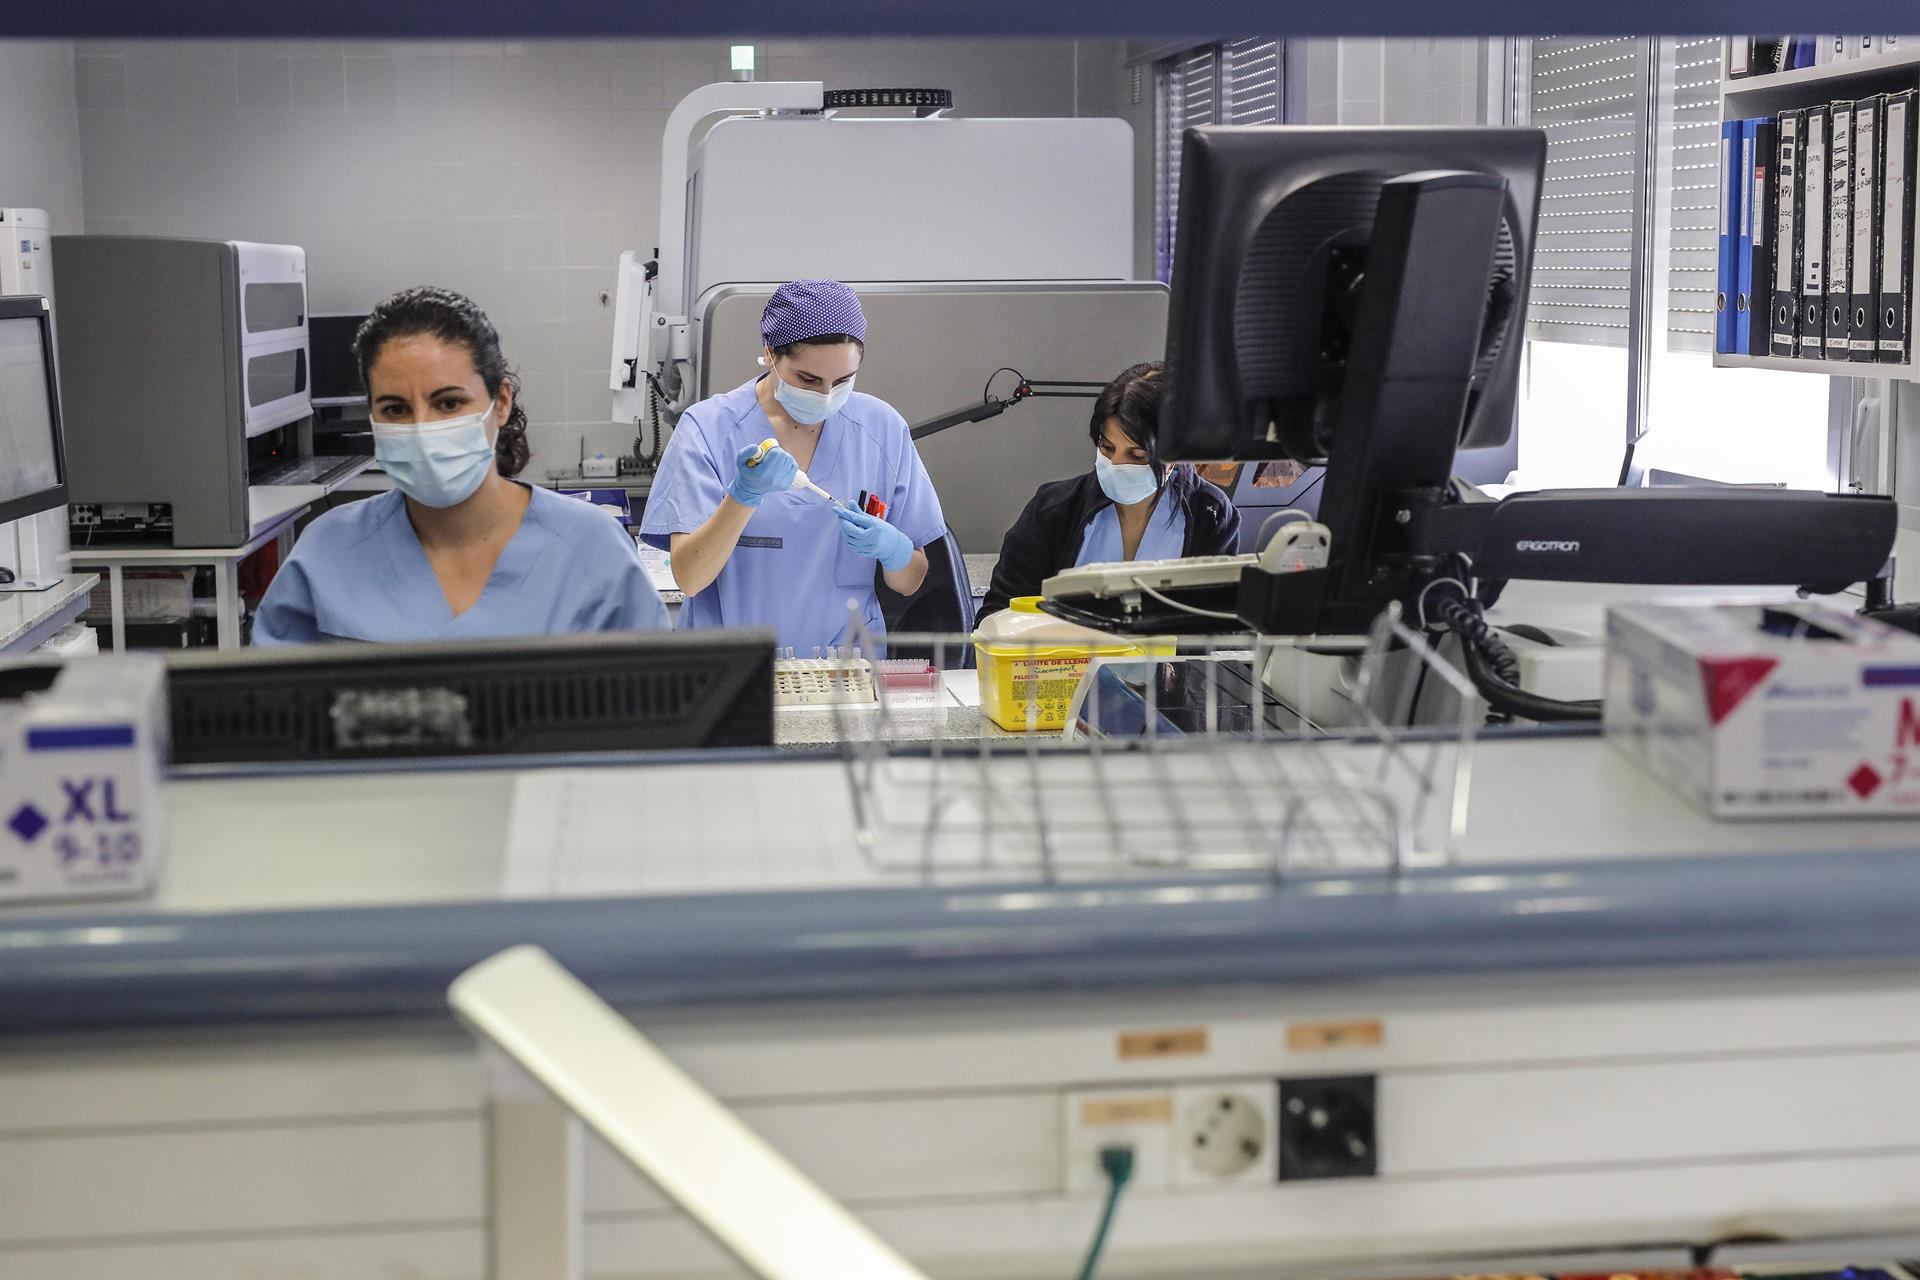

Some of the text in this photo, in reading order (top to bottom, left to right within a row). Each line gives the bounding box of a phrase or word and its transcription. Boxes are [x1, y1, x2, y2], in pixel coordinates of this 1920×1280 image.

[1516, 540, 1580, 552] ERGOTRON
[61, 778, 131, 823] XL
[54, 830, 140, 866] 9-10
